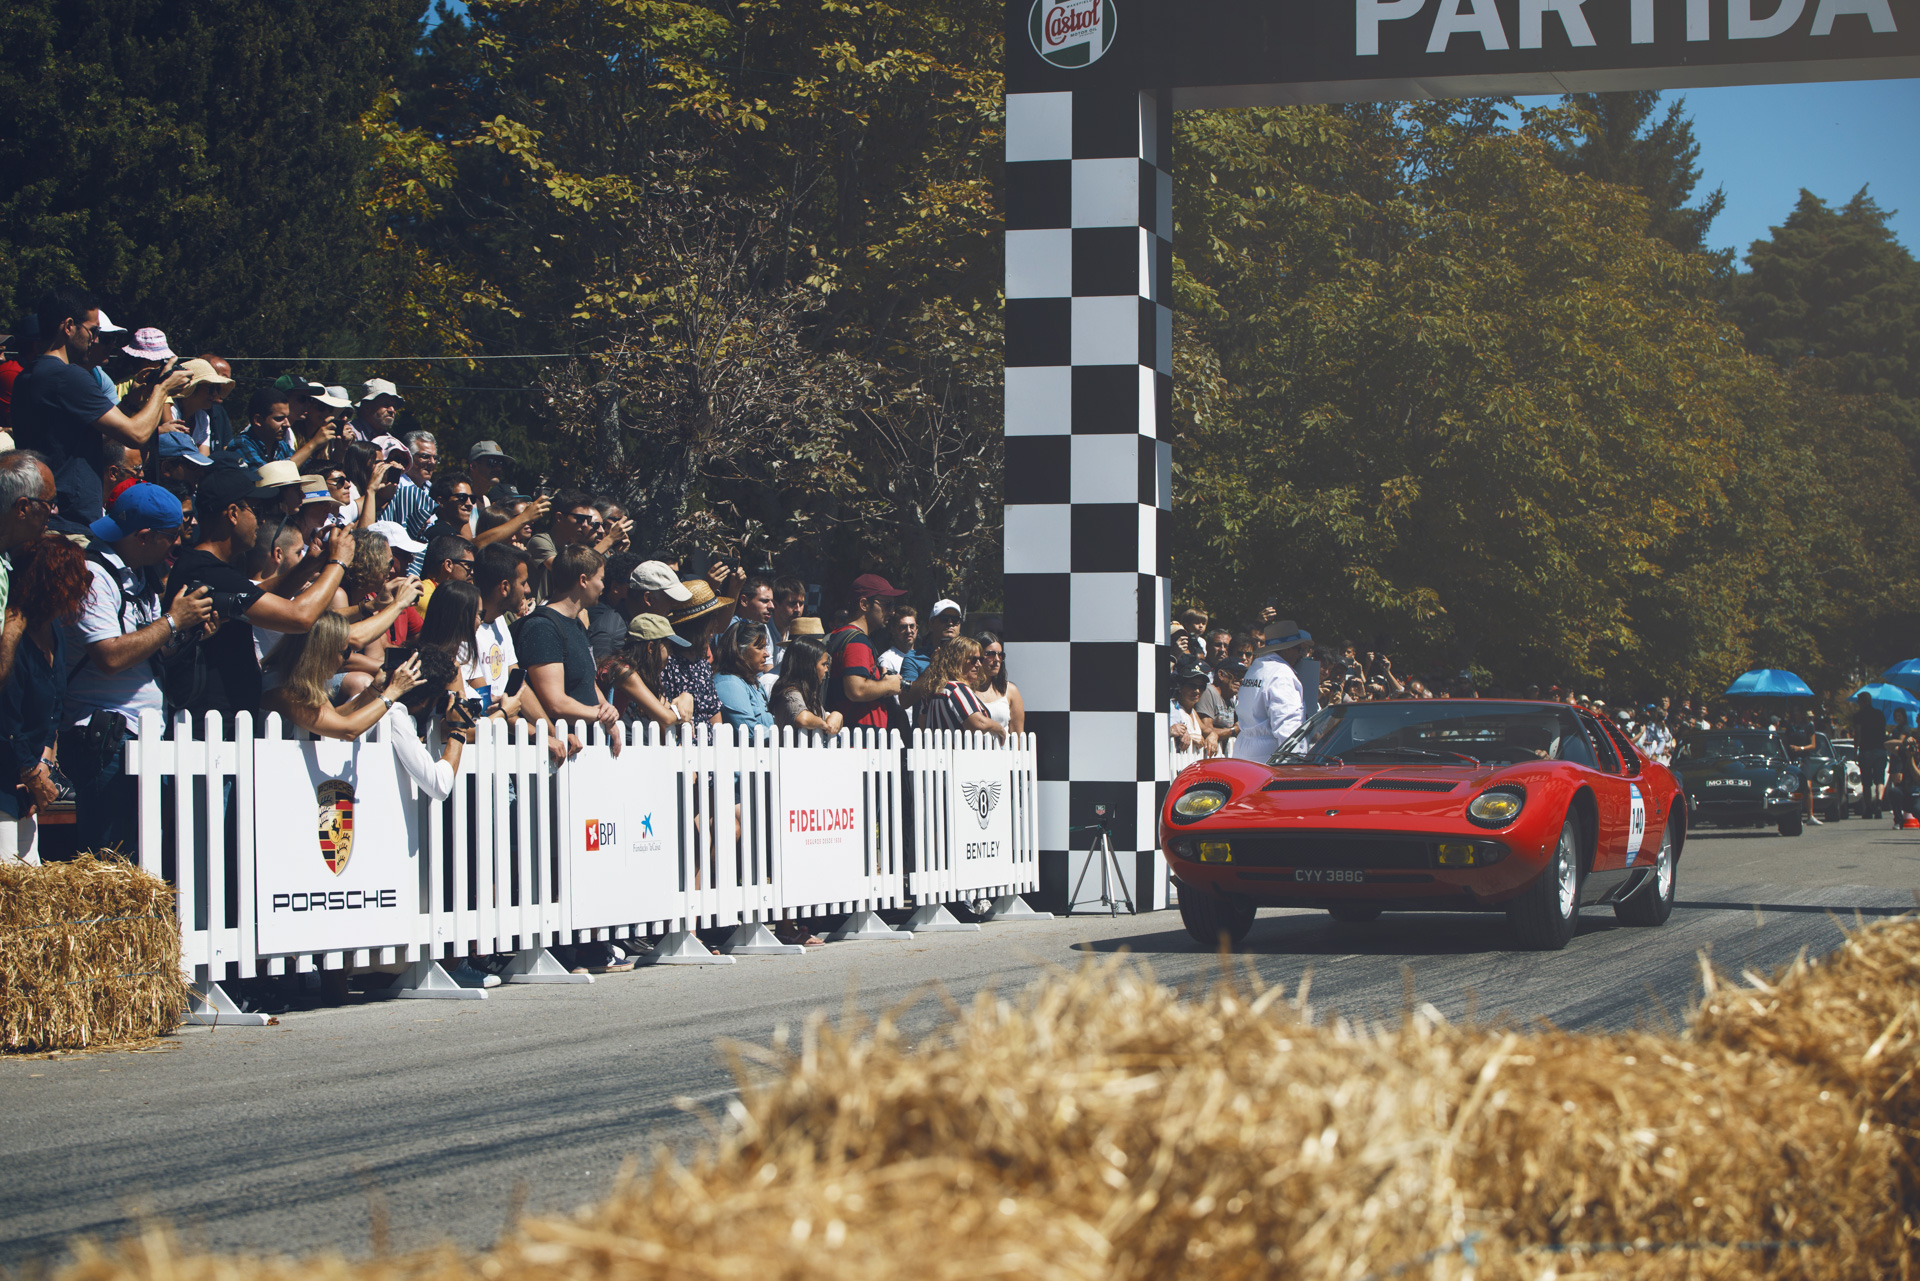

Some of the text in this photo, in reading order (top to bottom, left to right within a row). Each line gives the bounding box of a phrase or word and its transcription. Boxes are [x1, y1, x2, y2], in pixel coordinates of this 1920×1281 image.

[1045, 0, 1101, 46] Castrol
[318, 781, 353, 795] PORSCHE
[789, 807, 855, 833] FIDELIDADE
[1632, 807, 1644, 835] 140
[600, 822, 616, 846] BPI
[966, 840, 1000, 860] BENTLEY
[1295, 869, 1364, 882] CYY 388G
[272, 889, 397, 913] PORSCHE
